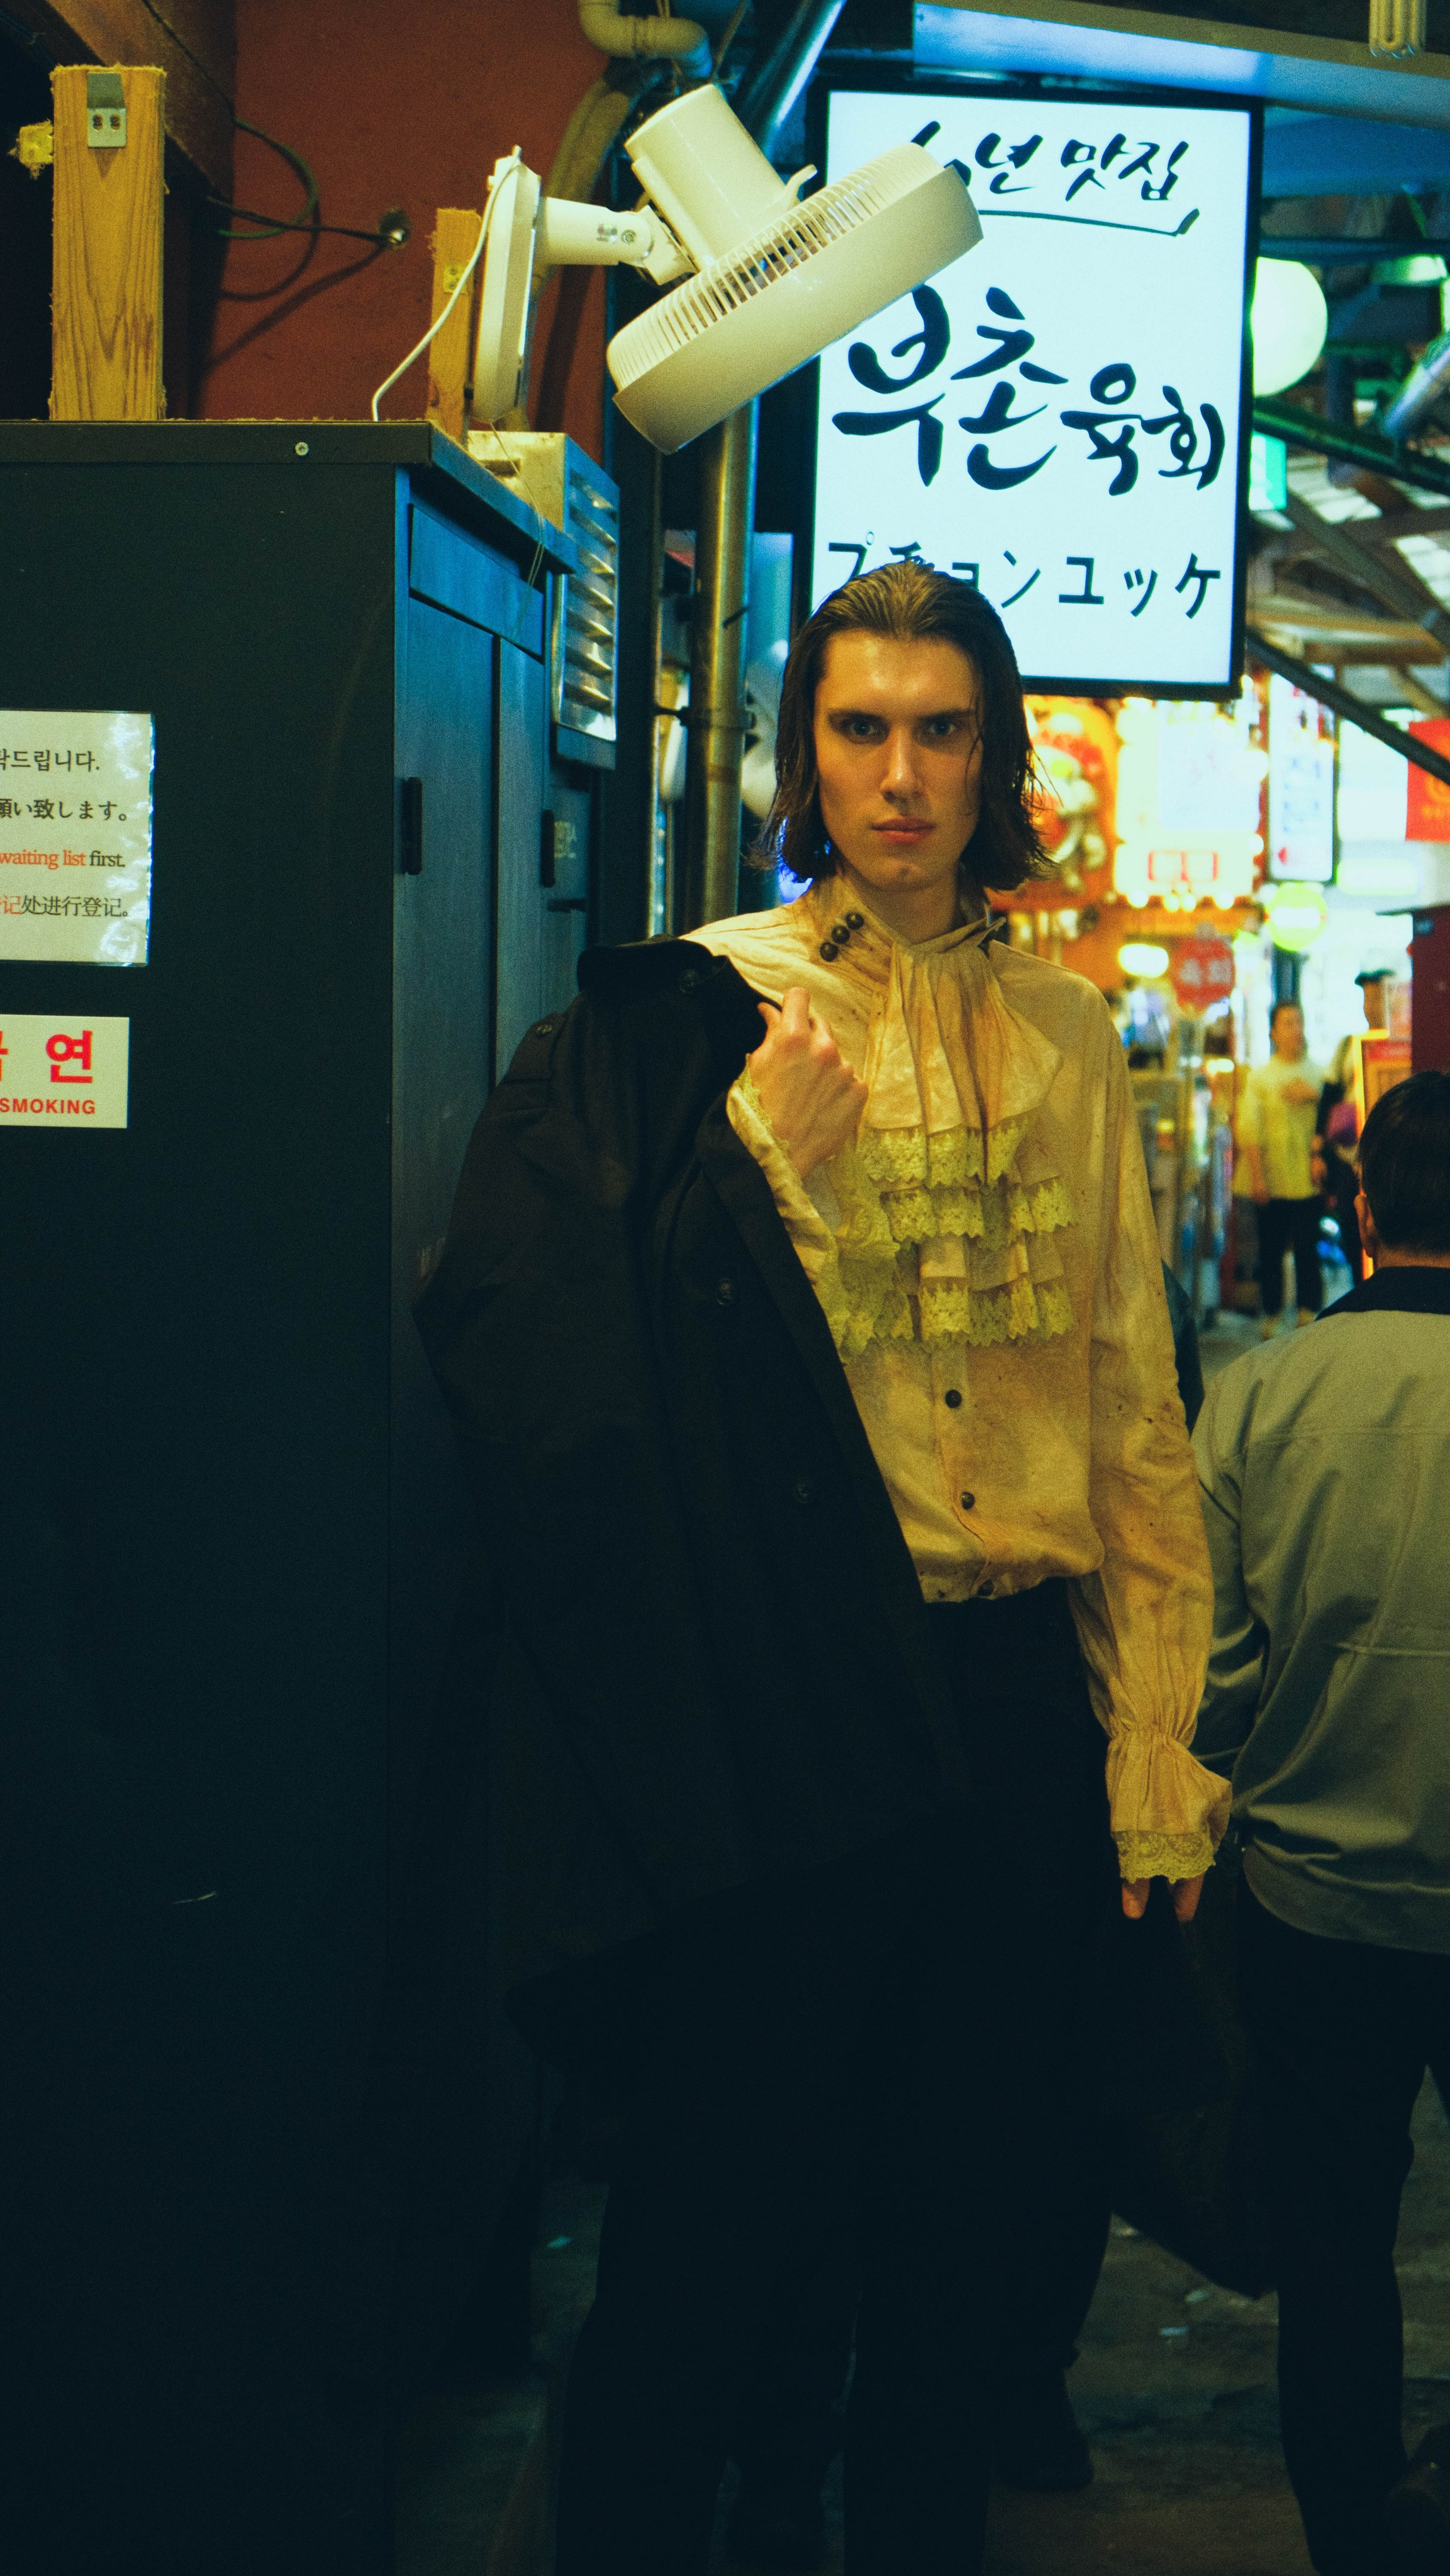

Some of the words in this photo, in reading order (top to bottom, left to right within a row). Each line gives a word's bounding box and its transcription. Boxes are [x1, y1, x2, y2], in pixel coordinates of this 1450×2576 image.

[1061, 133, 1190, 201] 맛집
[0, 849, 59, 870] waiting
[63, 849, 86, 866] list
[89, 850, 126, 867] first.
[0, 1097, 96, 1114] SMOKING
